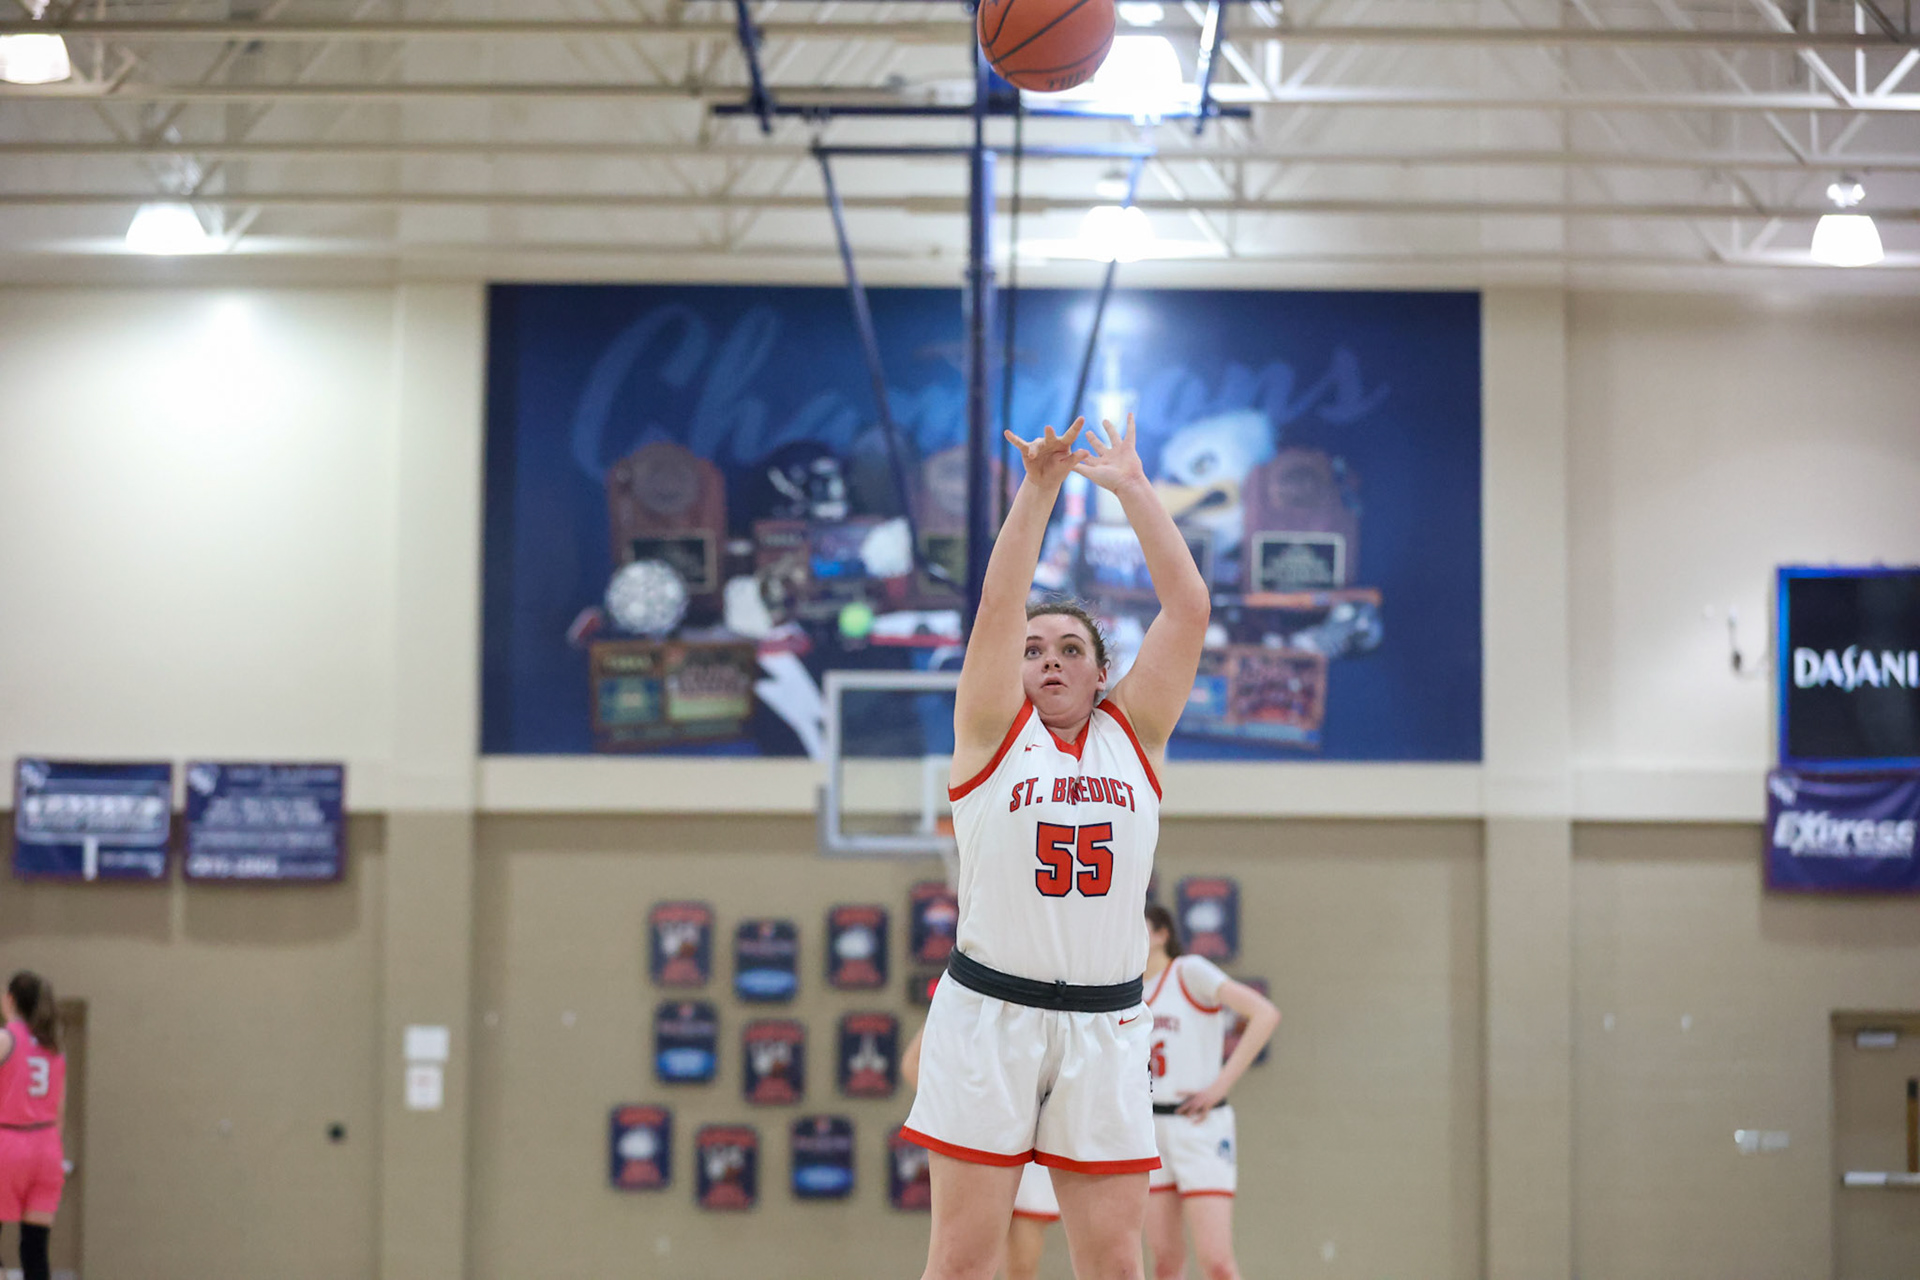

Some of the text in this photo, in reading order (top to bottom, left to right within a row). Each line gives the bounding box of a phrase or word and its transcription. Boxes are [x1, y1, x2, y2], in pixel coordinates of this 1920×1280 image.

[573, 304, 1388, 478] Chamons
[1793, 645, 1919, 692] DASANI
[1010, 777, 1043, 813] ST.
[1035, 821, 1113, 897] 55
[27, 1056, 49, 1097] 3
